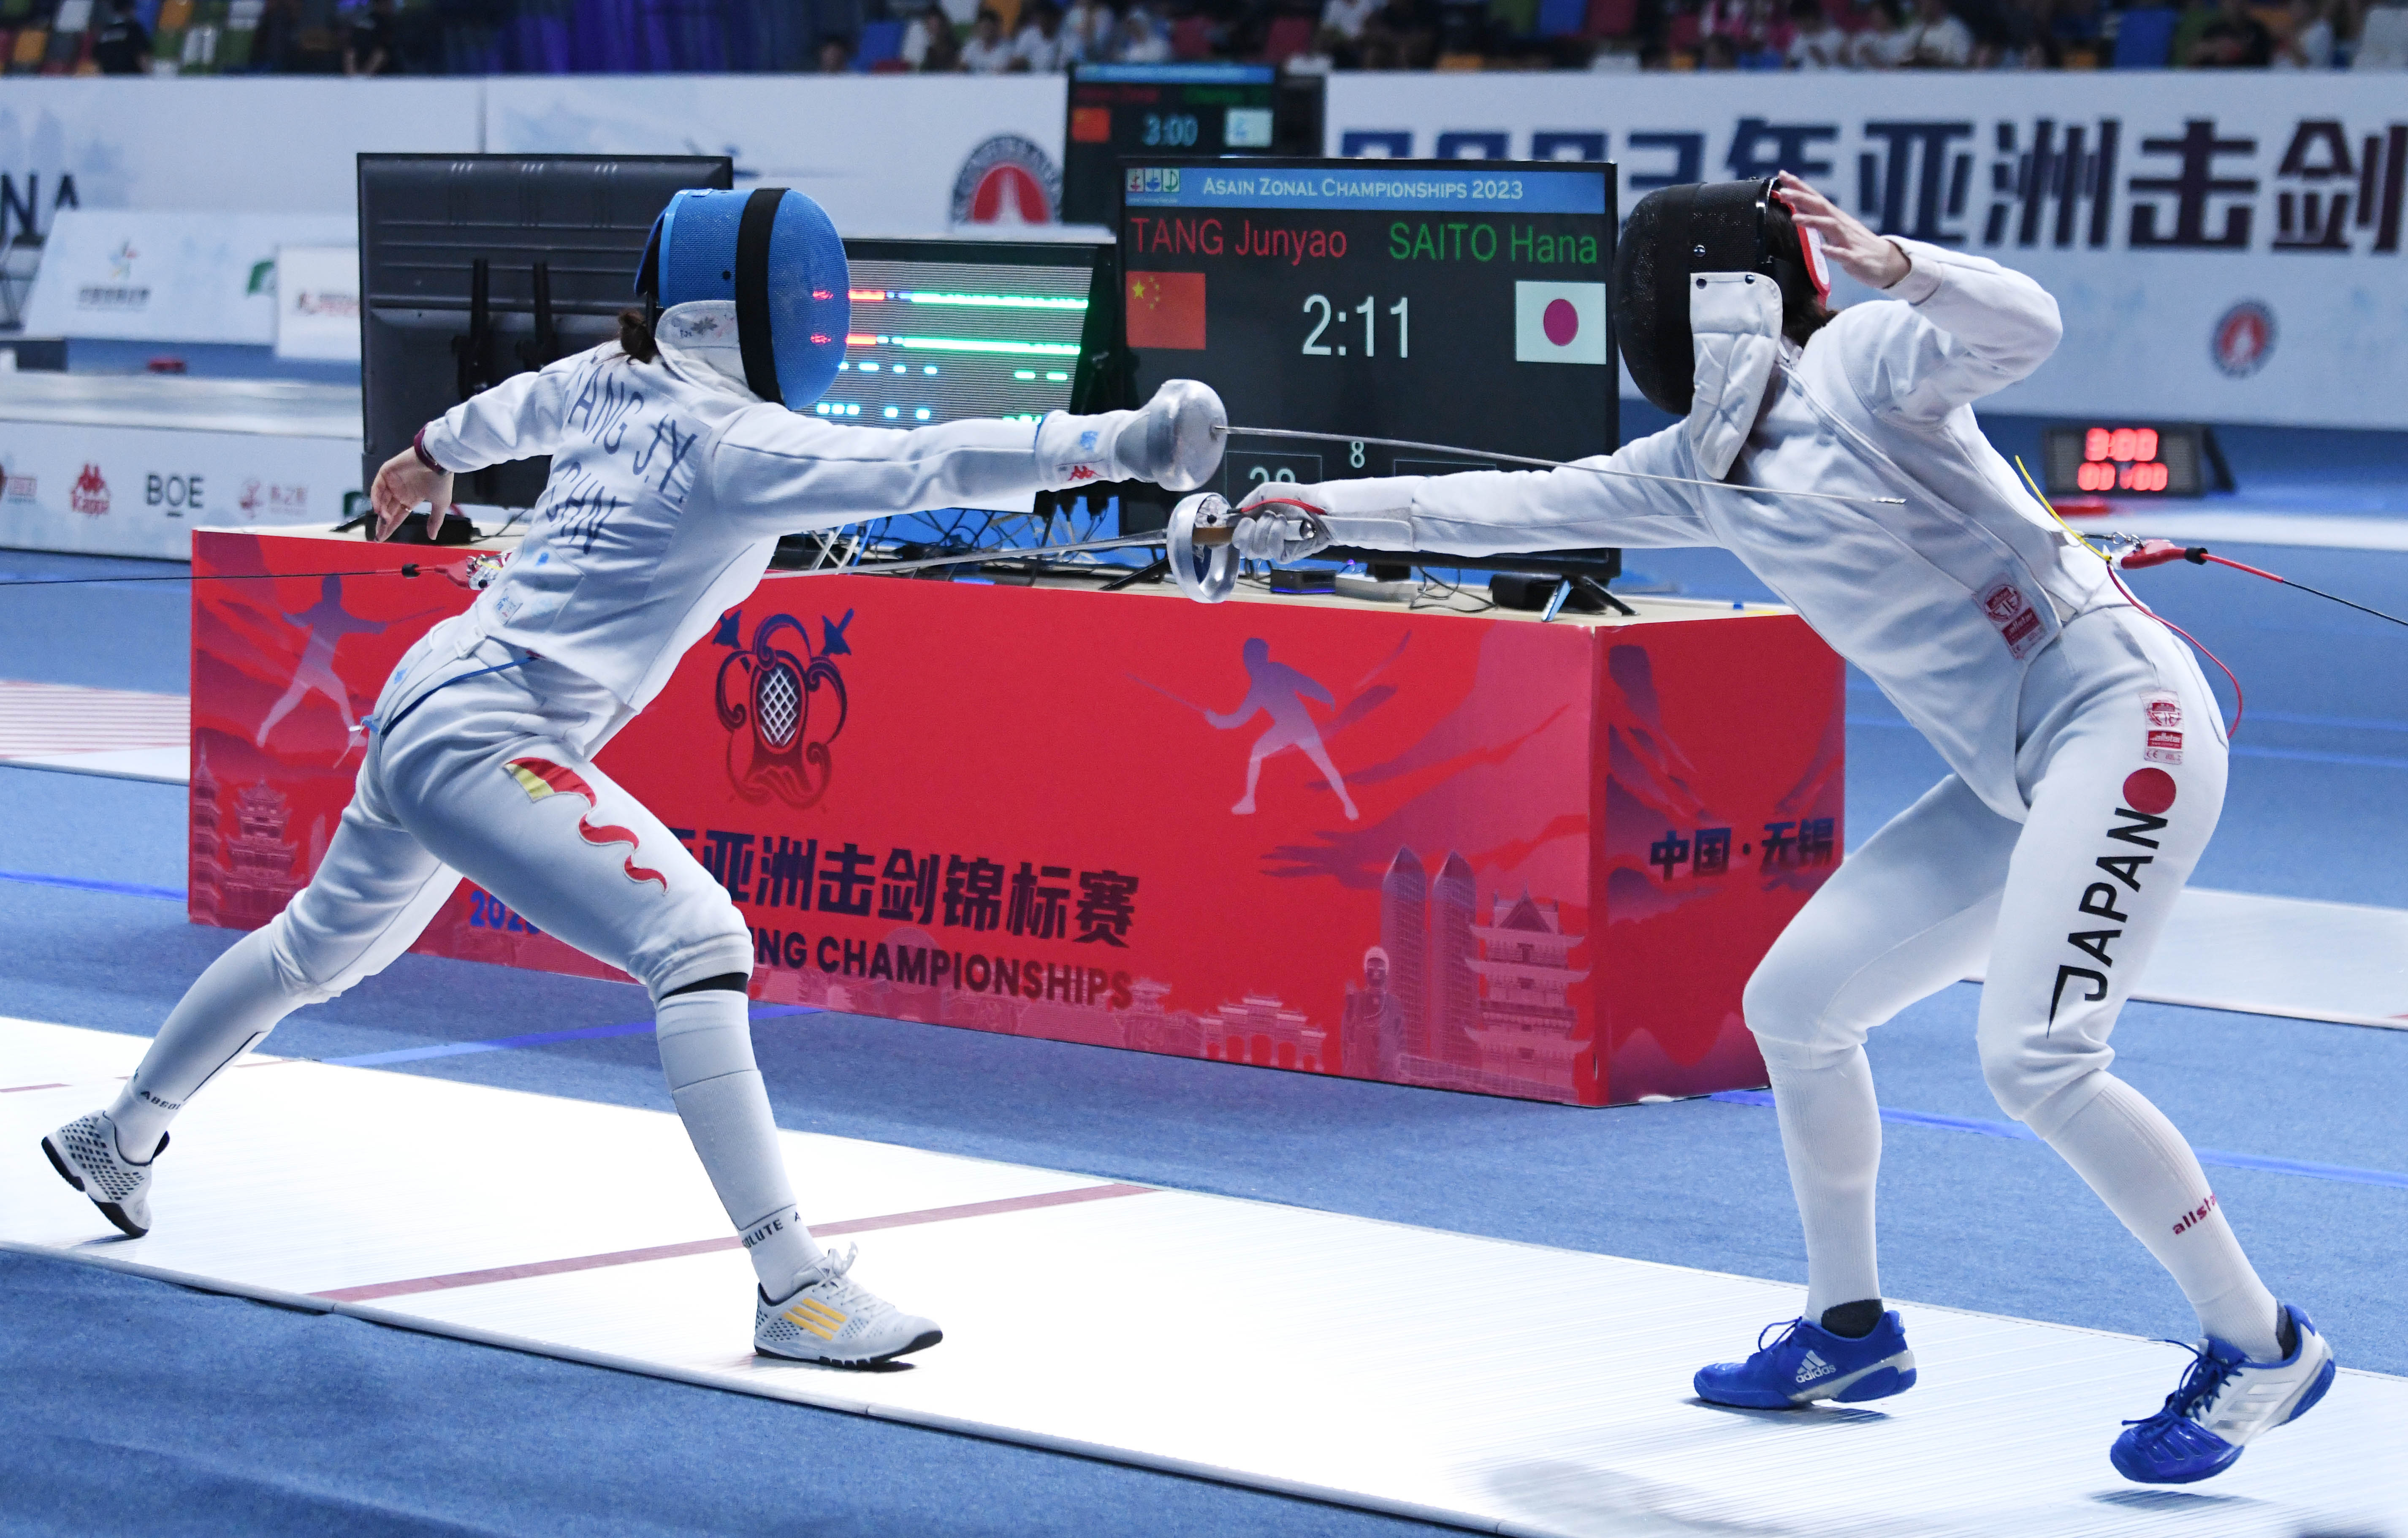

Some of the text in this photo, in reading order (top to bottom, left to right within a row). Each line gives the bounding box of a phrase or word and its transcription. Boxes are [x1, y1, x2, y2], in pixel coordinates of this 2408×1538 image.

[1142, 114, 1199, 146] 3:00
[1259, 178, 1318, 197] ZONAL
[1322, 178, 1467, 199] CHAMPIONSHIPS
[1472, 180, 1523, 199] 2023
[1131, 218, 1348, 266] TANG Junyao
[1389, 222, 1597, 264] SAITO Hana
[1302, 294, 1408, 358] 2:11
[1351, 440, 1365, 469] 8
[146, 472, 205, 508] BOE
[669, 827, 1139, 949] 亚洲击剑锦标赛
[2047, 807, 2168, 1039] JAPAN
[817, 936, 1133, 1010] CHAMPIONSHIPS
[1796, 1364, 1836, 1383] adidas
